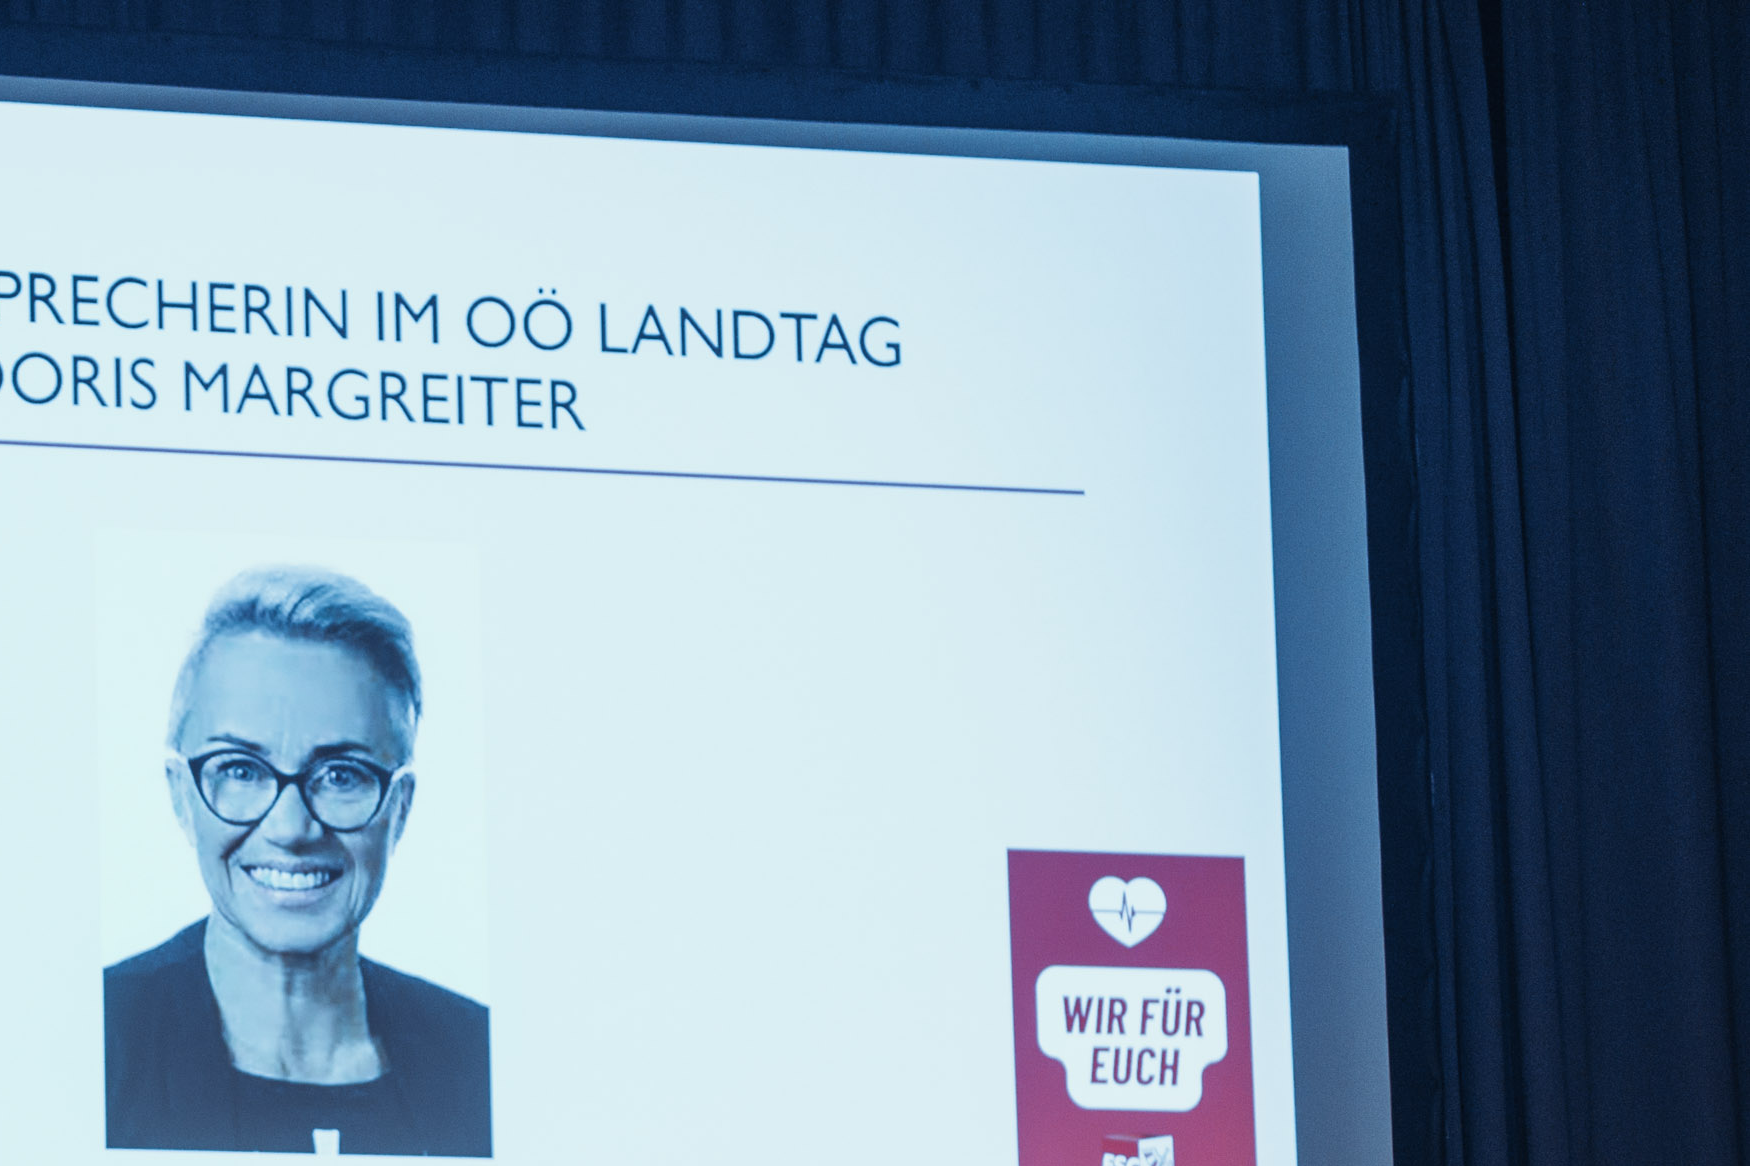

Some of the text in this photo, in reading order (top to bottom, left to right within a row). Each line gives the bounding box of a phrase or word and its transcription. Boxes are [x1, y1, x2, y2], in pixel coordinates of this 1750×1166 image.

[377, 291, 439, 344] IM
[466, 287, 573, 351] OÖ
[600, 303, 901, 368] LANDTAG
[184, 361, 586, 431] MARGREITER
[1063, 987, 1205, 1037] WIR FÜR
[1090, 1047, 1180, 1086] EUCH
